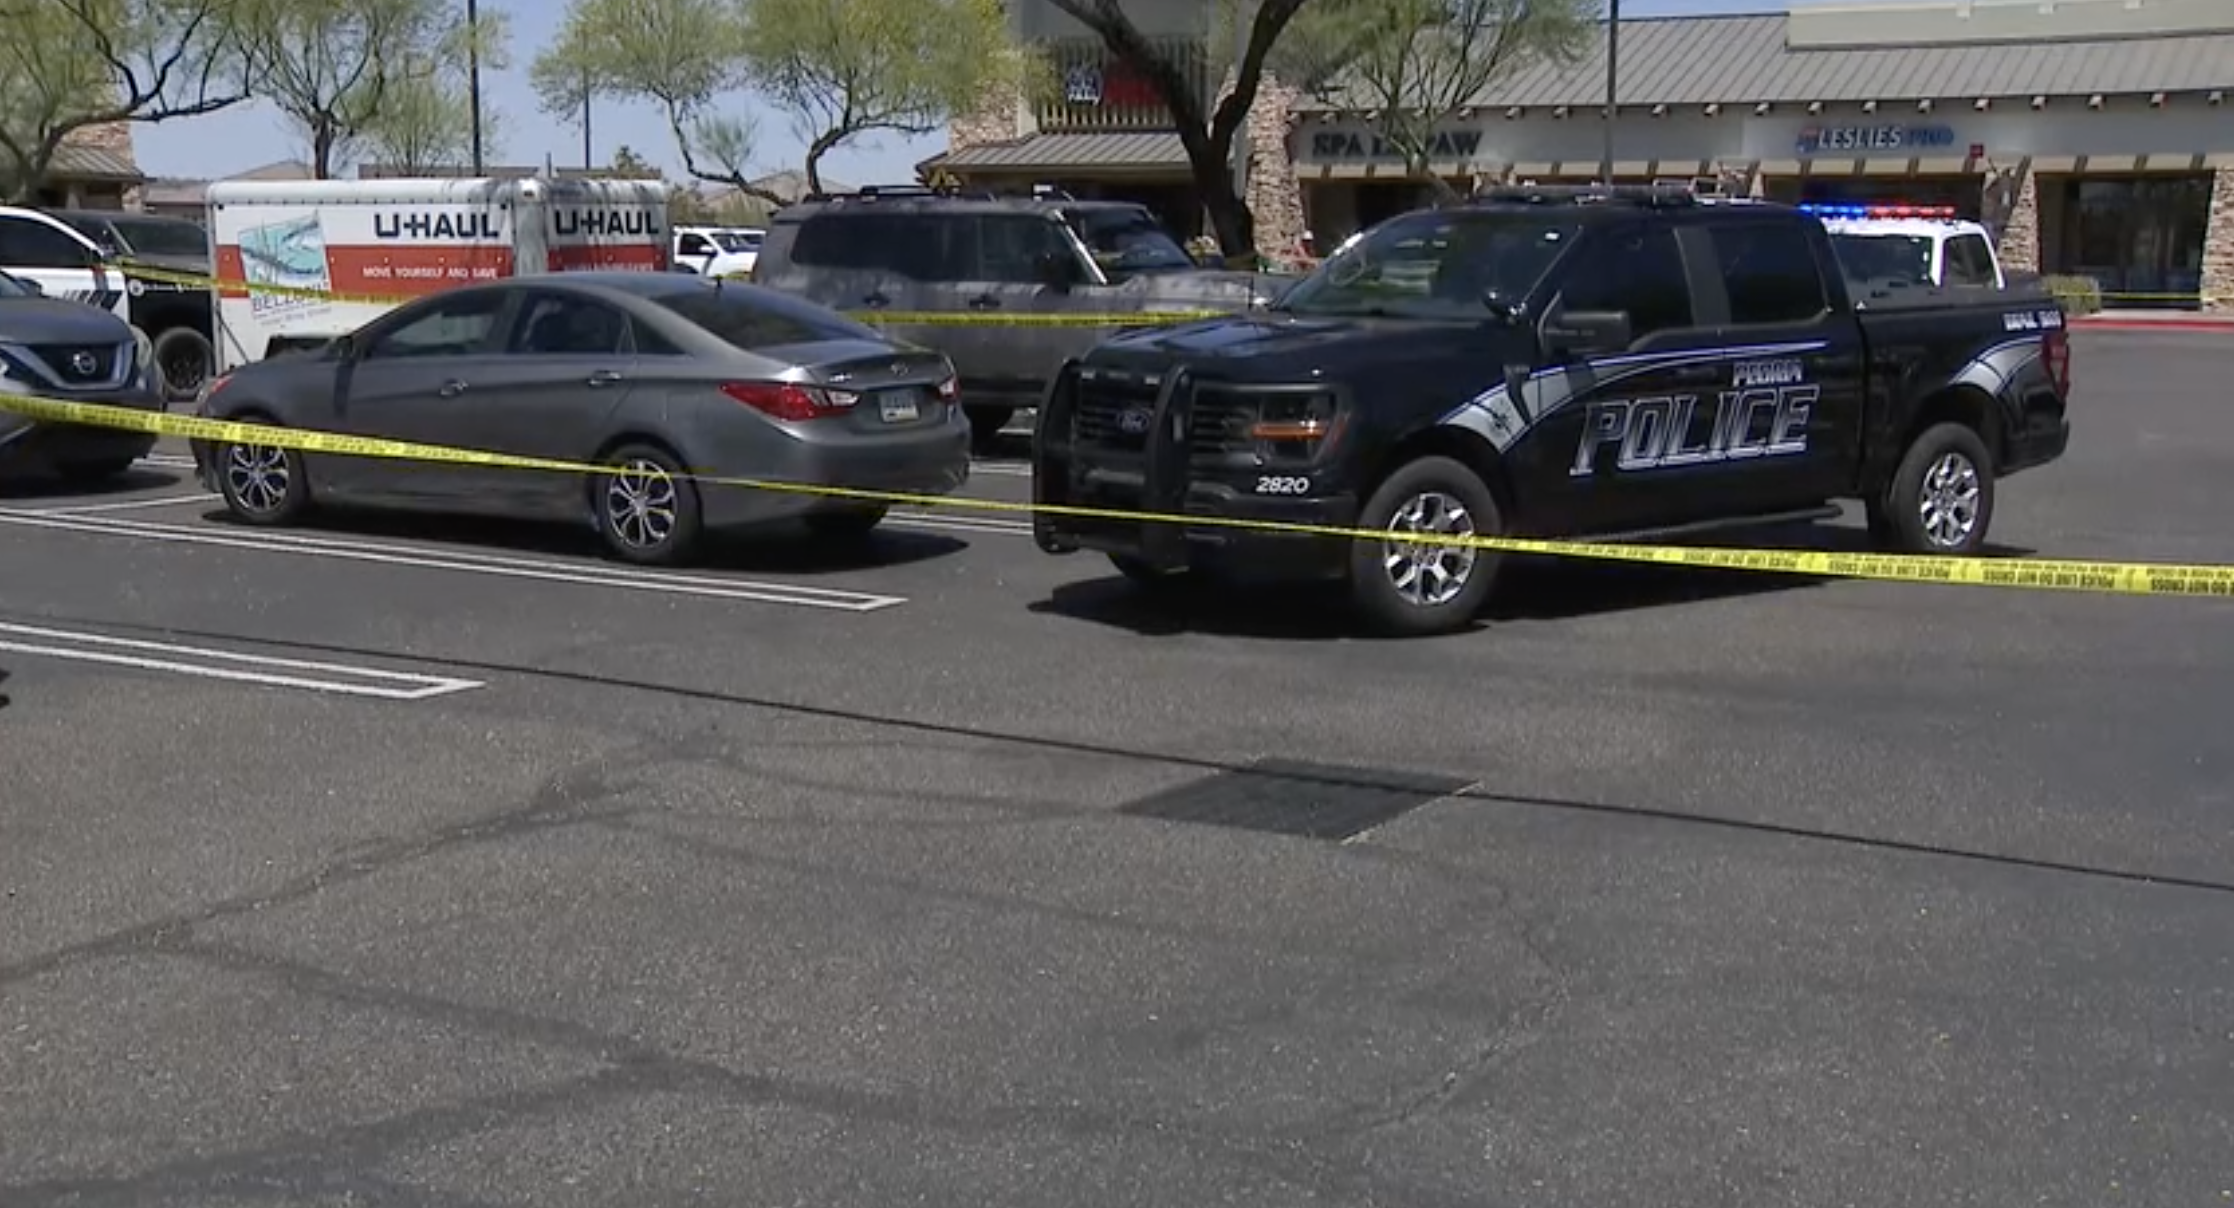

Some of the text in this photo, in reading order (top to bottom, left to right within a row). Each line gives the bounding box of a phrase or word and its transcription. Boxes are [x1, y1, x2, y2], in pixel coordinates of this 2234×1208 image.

[1313, 132, 1365, 157] SPA
[374, 213, 499, 238] U-HAUL
[556, 209, 660, 235] U-HAUL
[363, 265, 498, 279] MOVE YOURSELF AND SAVE
[1569, 383, 1820, 476] POLICE
[1255, 476, 1310, 494] 2820
